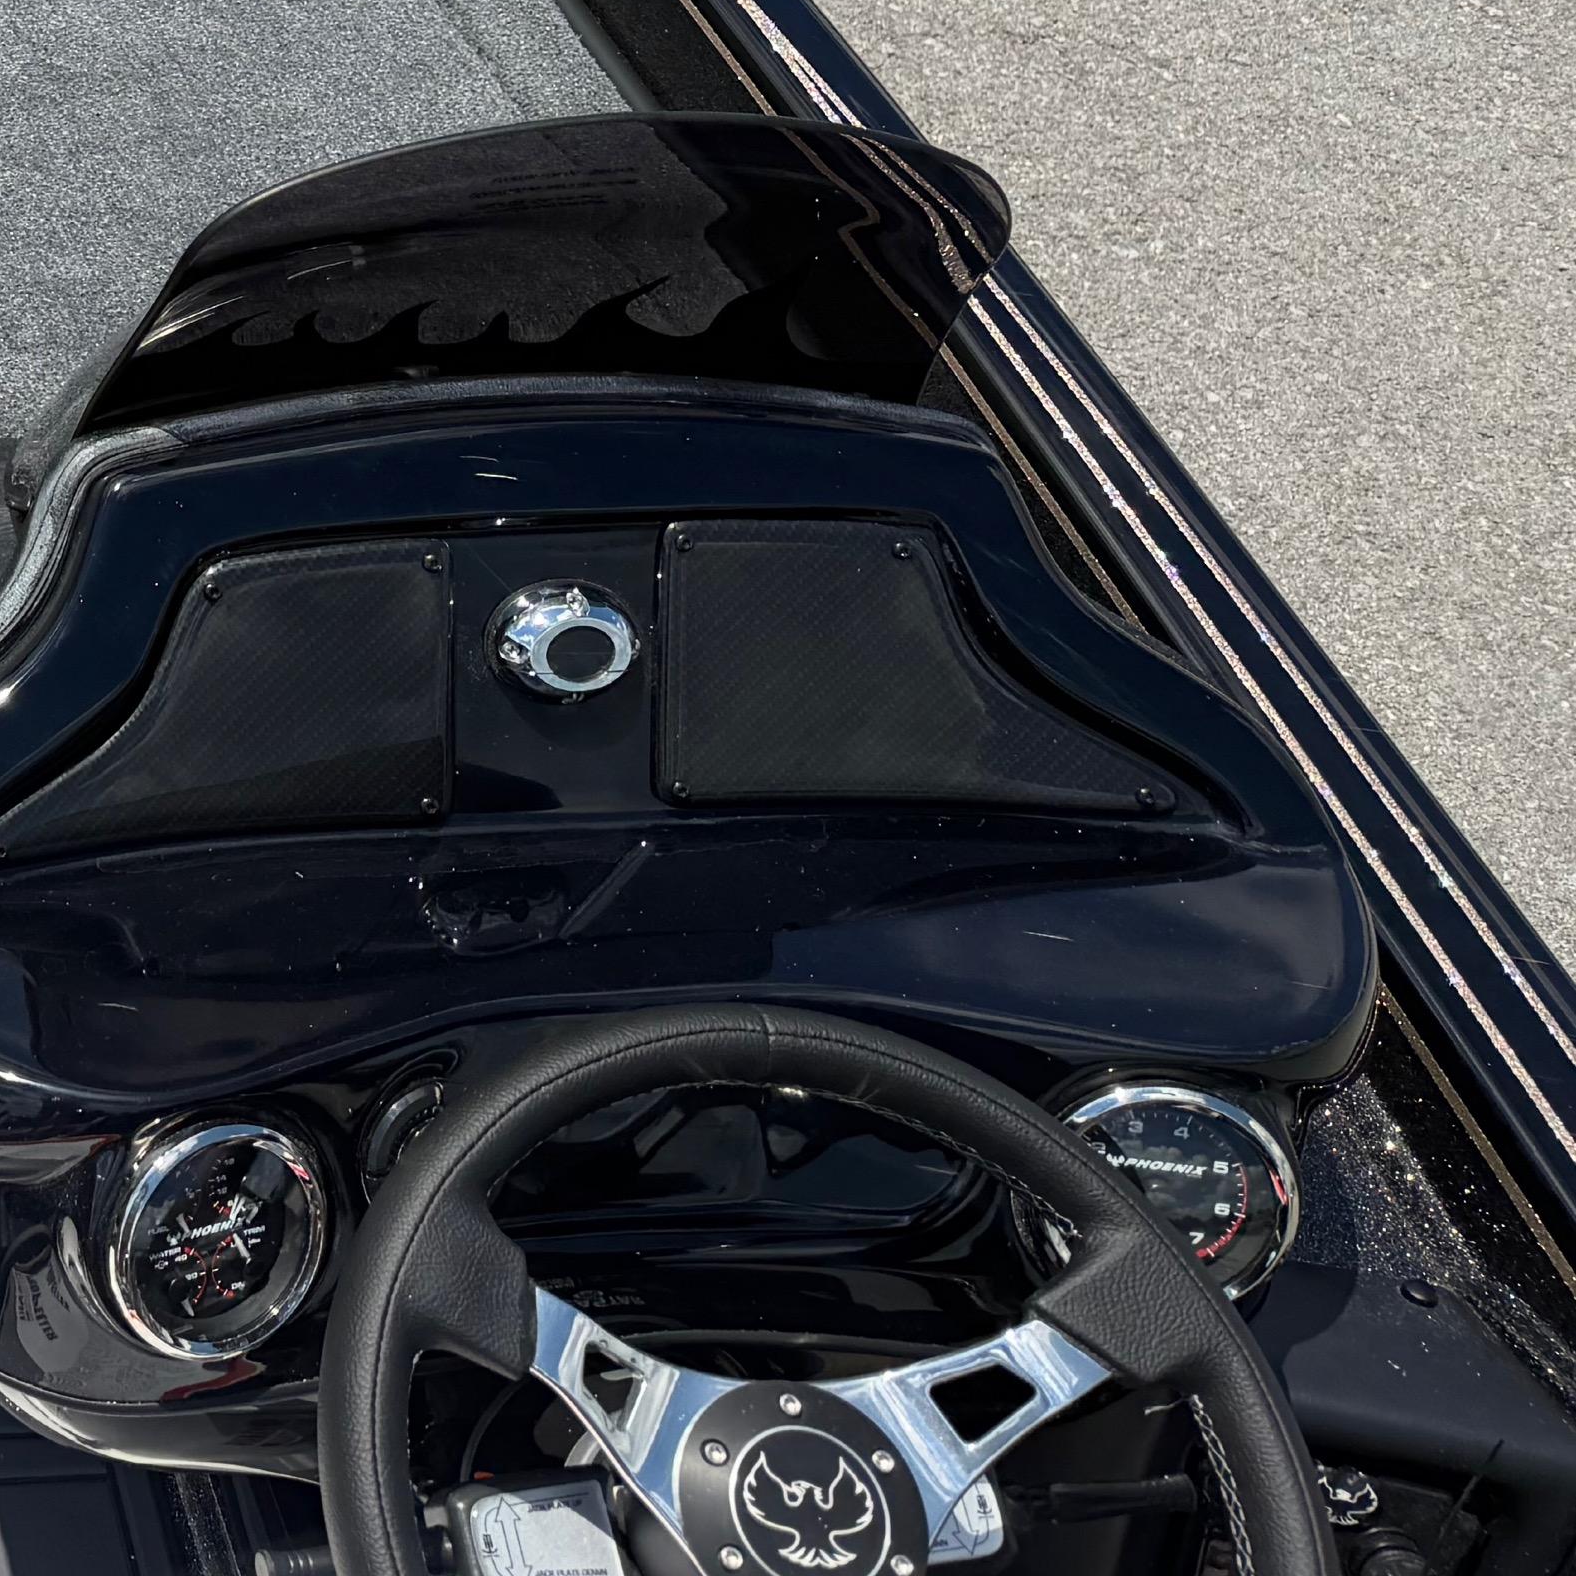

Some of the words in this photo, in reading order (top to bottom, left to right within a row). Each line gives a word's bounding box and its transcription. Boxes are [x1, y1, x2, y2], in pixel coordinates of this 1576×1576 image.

[1128, 1121, 1143, 1134] 3
[1173, 1127, 1189, 1140] 4
[1123, 1157, 1209, 1176] PHOENIX
[1212, 1160, 1229, 1175] 5
[1214, 1203, 1231, 1216] 6
[1189, 1231, 1205, 1245] 7
